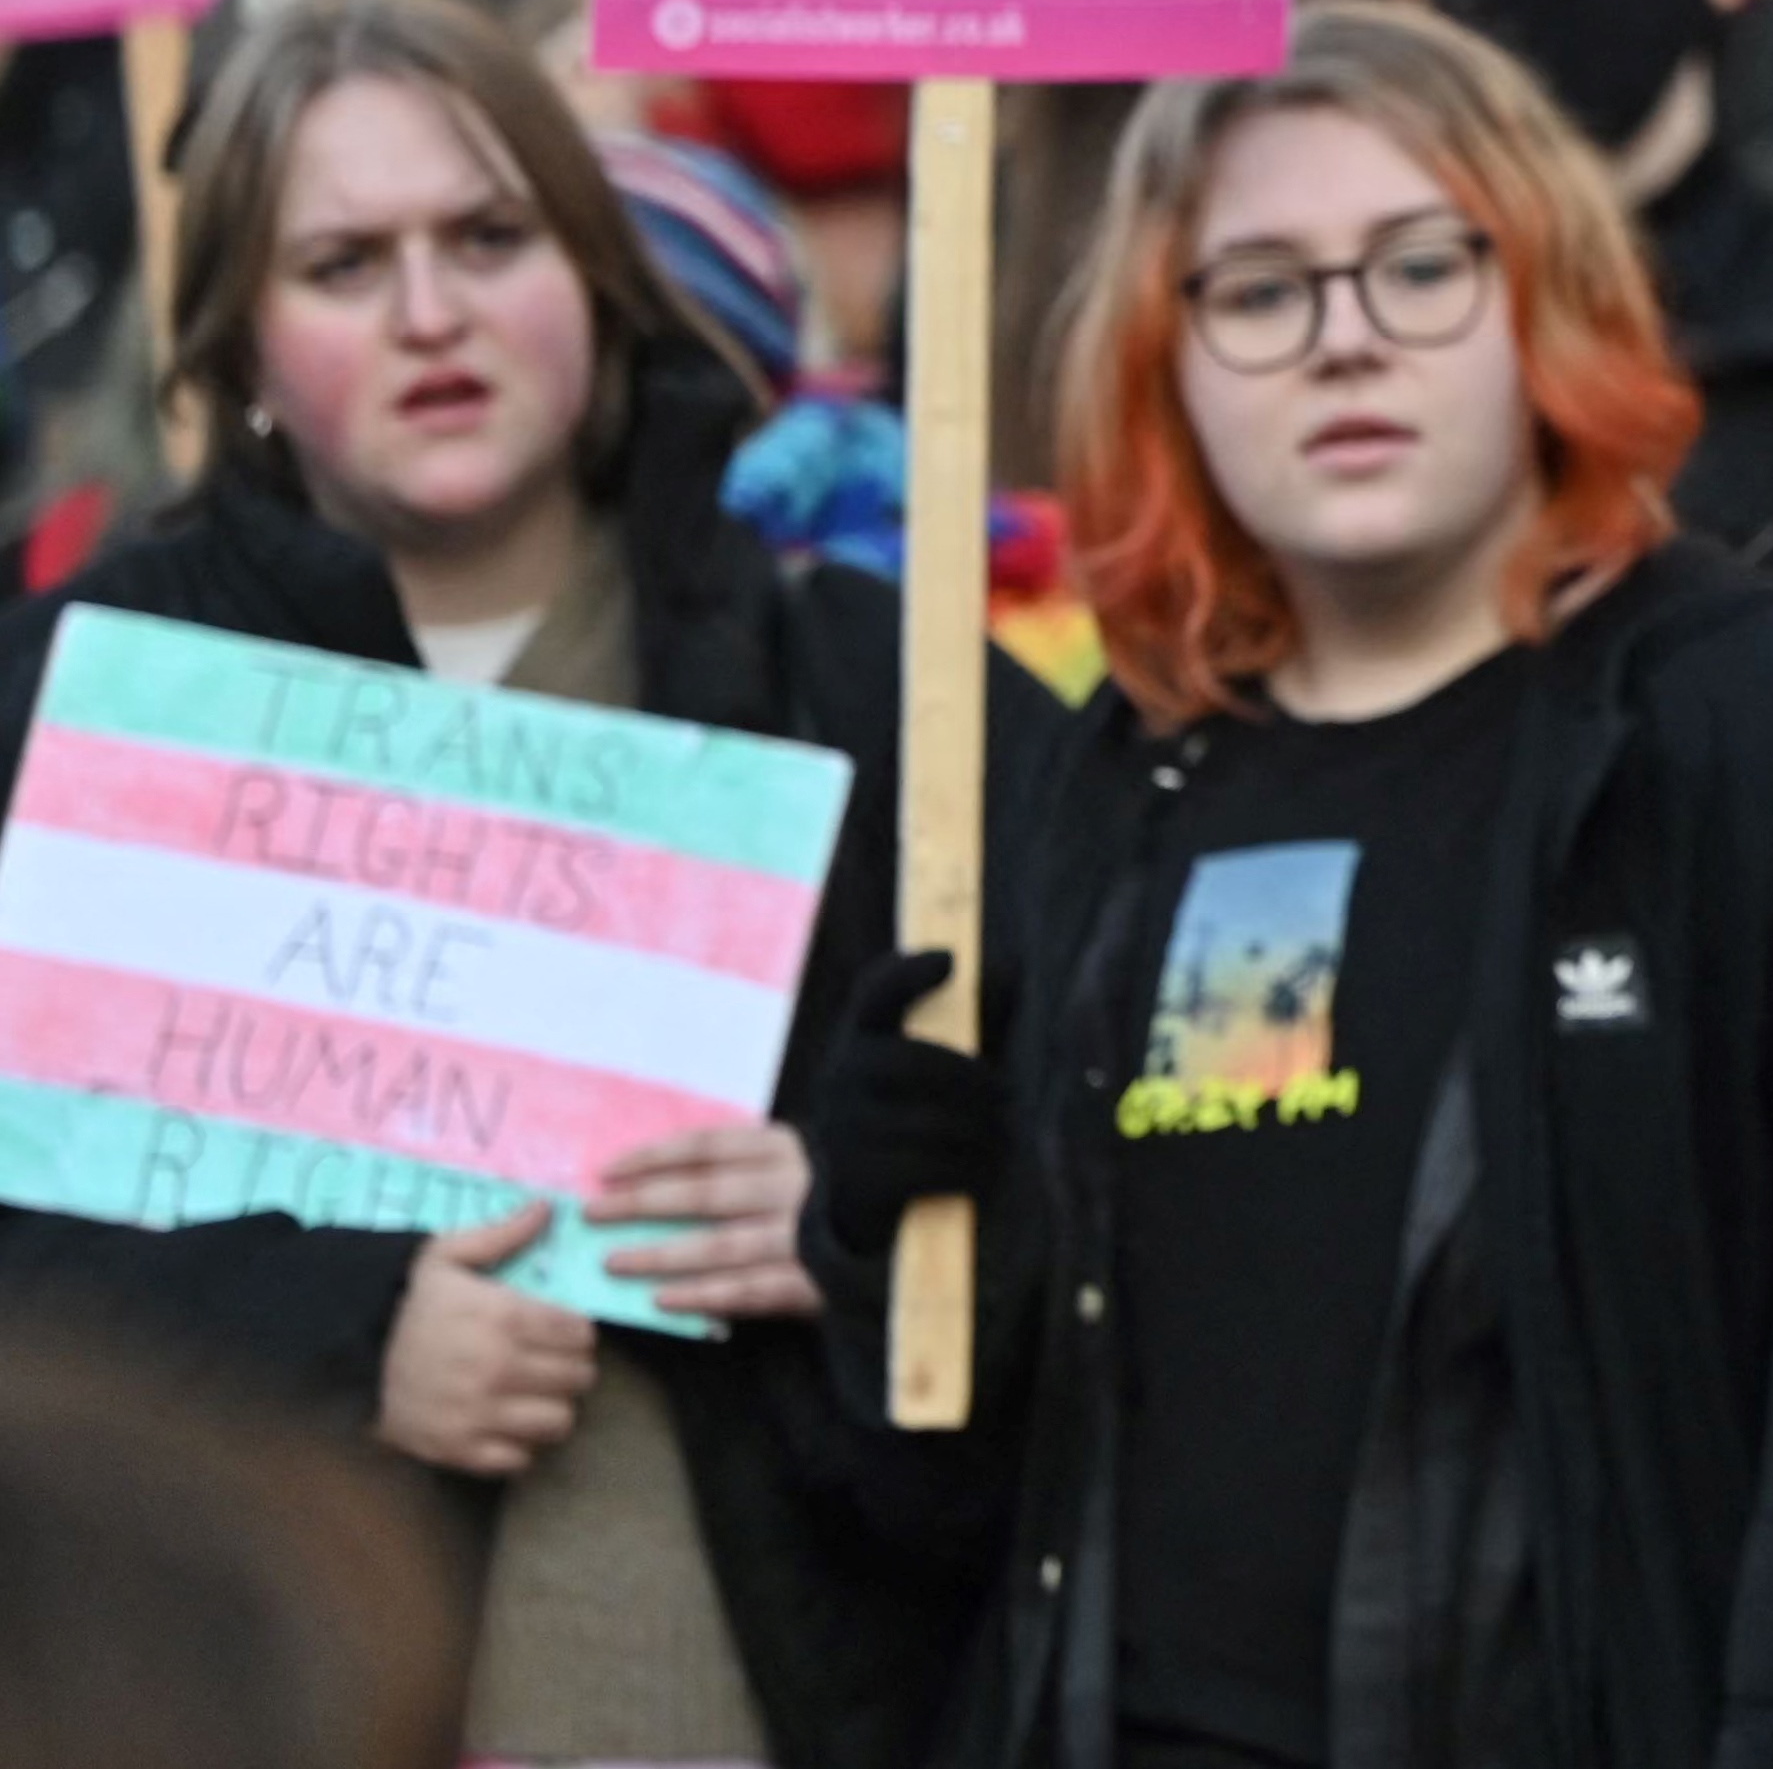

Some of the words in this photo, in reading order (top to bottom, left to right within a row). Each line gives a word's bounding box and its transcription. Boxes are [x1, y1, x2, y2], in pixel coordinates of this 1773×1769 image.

[250, 660, 641, 819] TRANS
[213, 762, 622, 933] RIGHTS
[264, 897, 495, 1022] ARE
[145, 986, 515, 1151] HUMAN
